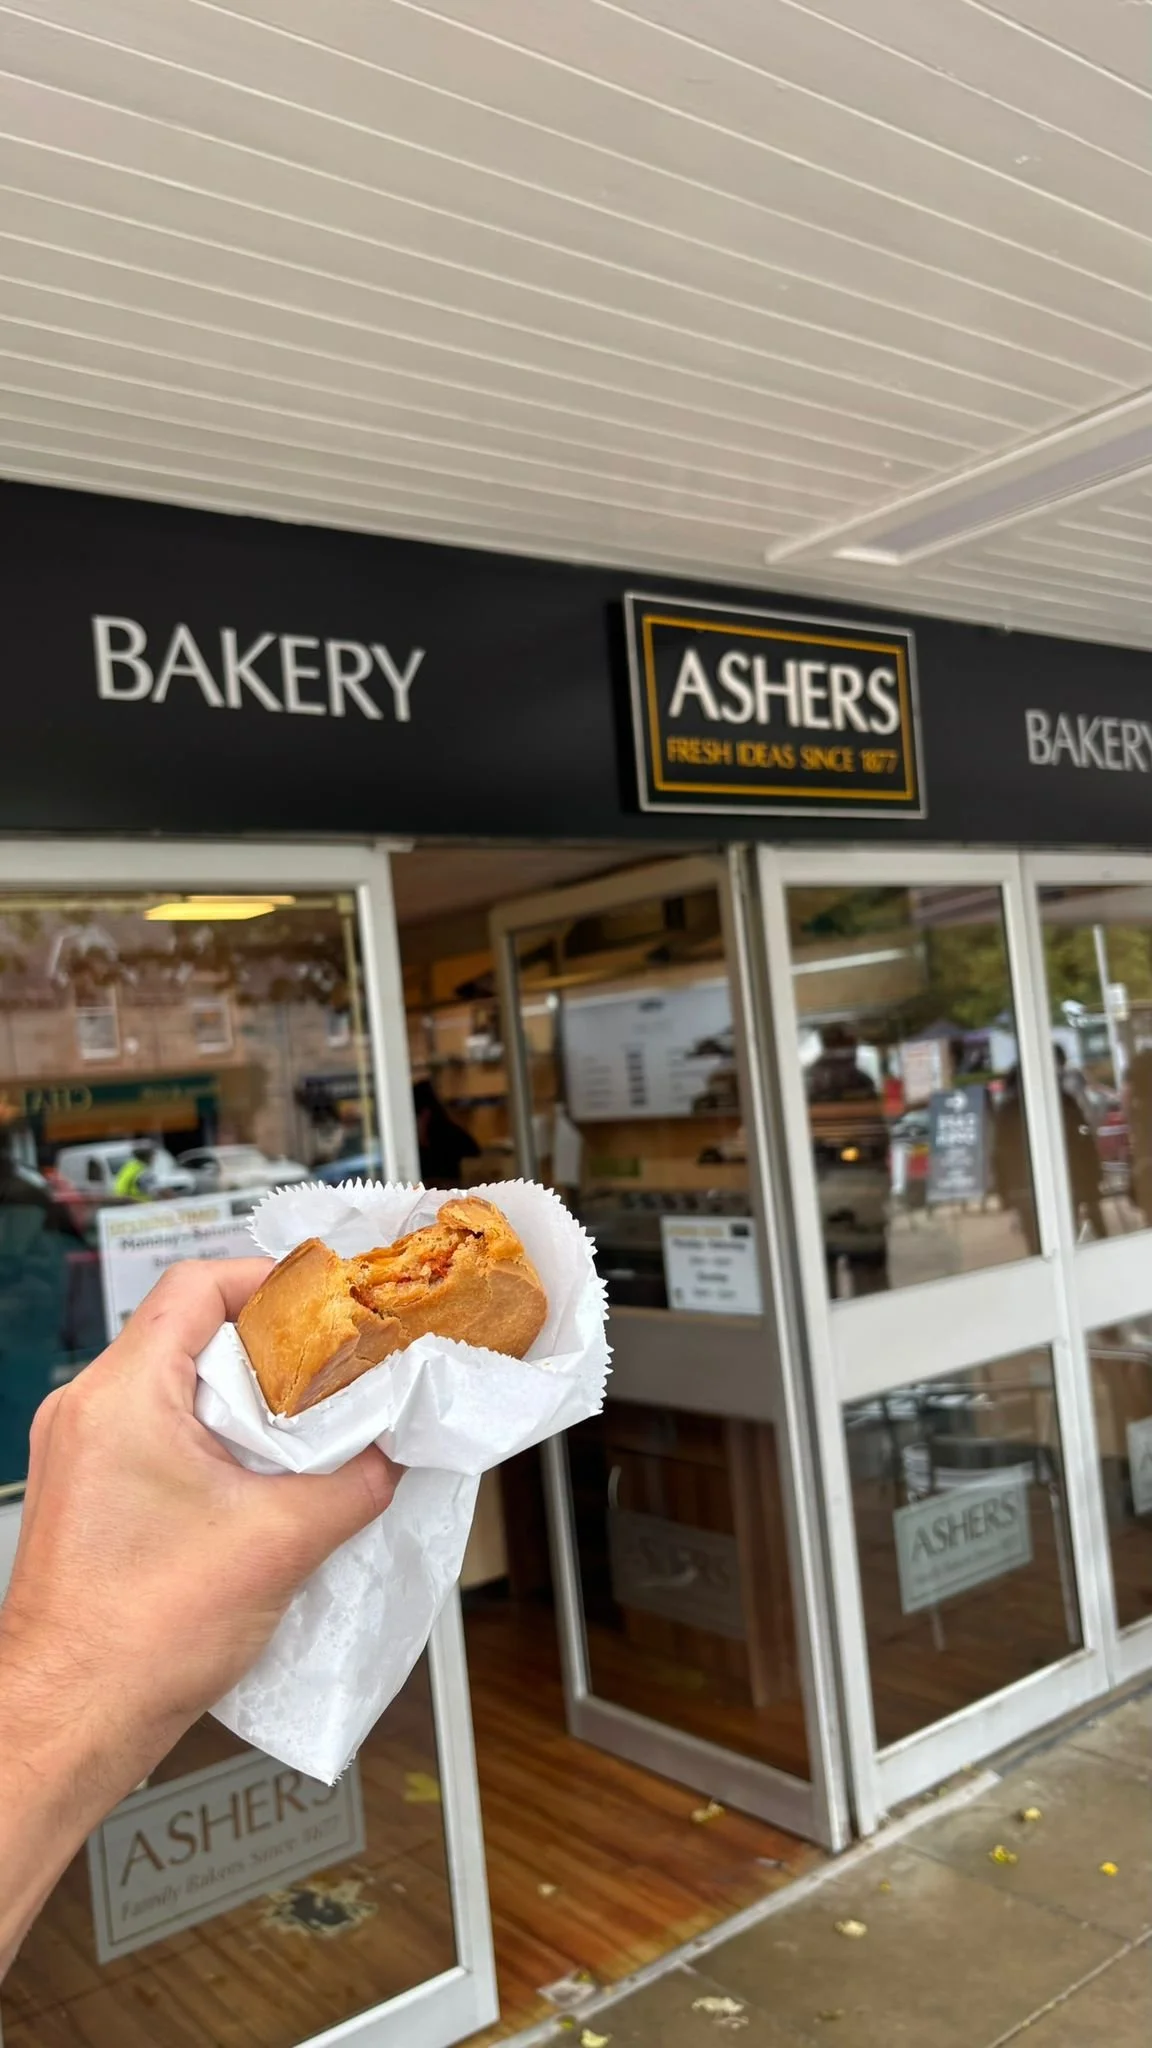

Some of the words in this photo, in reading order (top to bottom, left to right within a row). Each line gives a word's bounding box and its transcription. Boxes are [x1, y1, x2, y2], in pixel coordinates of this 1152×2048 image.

[92, 614, 426, 722] BAKERY
[668, 647, 900, 735] ASHERS
[666, 736, 732, 765] FRESH
[737, 740, 796, 770] IDEAS
[801, 744, 856, 773] SINCE
[860, 748, 899, 774] 1877
[910, 1490, 1017, 1562] ASHERS
[184, 1860, 246, 1895] Bakers
[249, 1838, 297, 1865] Since
